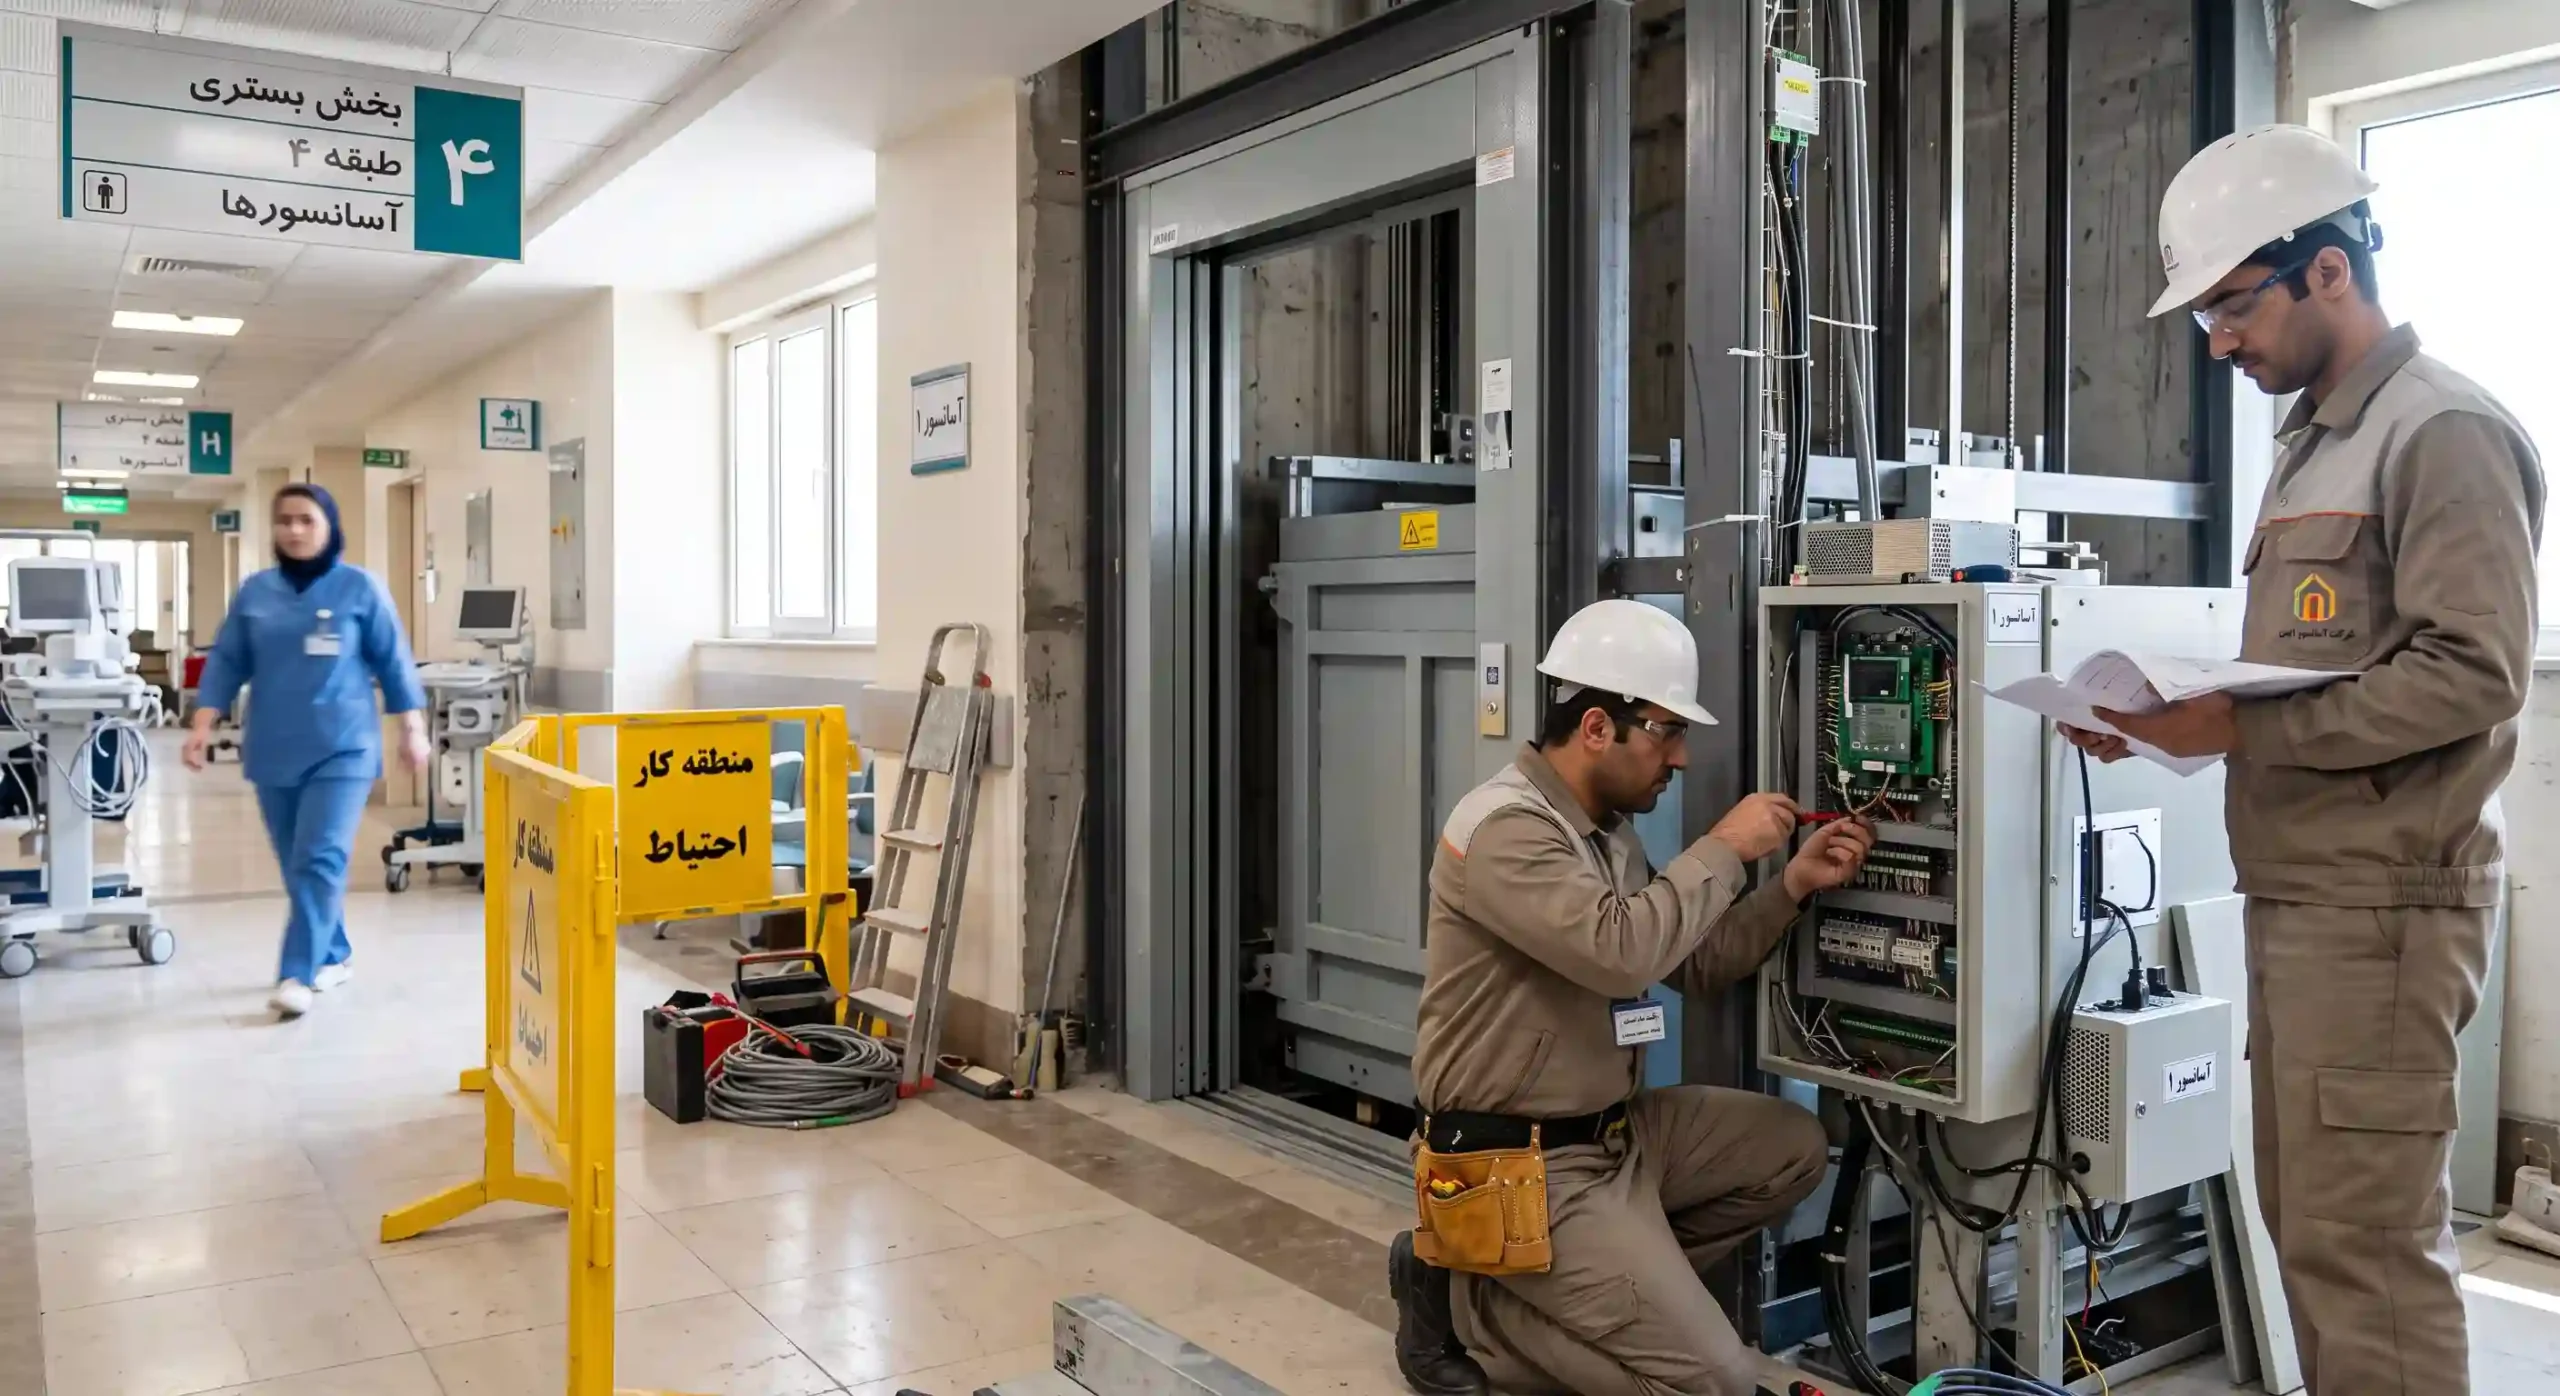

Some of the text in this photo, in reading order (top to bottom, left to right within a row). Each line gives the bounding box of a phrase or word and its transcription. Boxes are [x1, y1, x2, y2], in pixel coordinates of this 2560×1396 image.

[189, 77, 402, 127] بخش بستری
[288, 137, 402, 182] طبقه ۴
[441, 138, 495, 206] ۴
[222, 189, 404, 232] آسانسورها
[924, 396, 964, 437] آسانسور
[1999, 607, 2036, 628] آسانسور
[633, 747, 754, 788] منطقه کار
[644, 825, 747, 870] احتیاط
[2176, 1061, 2212, 1093] آسانسور
